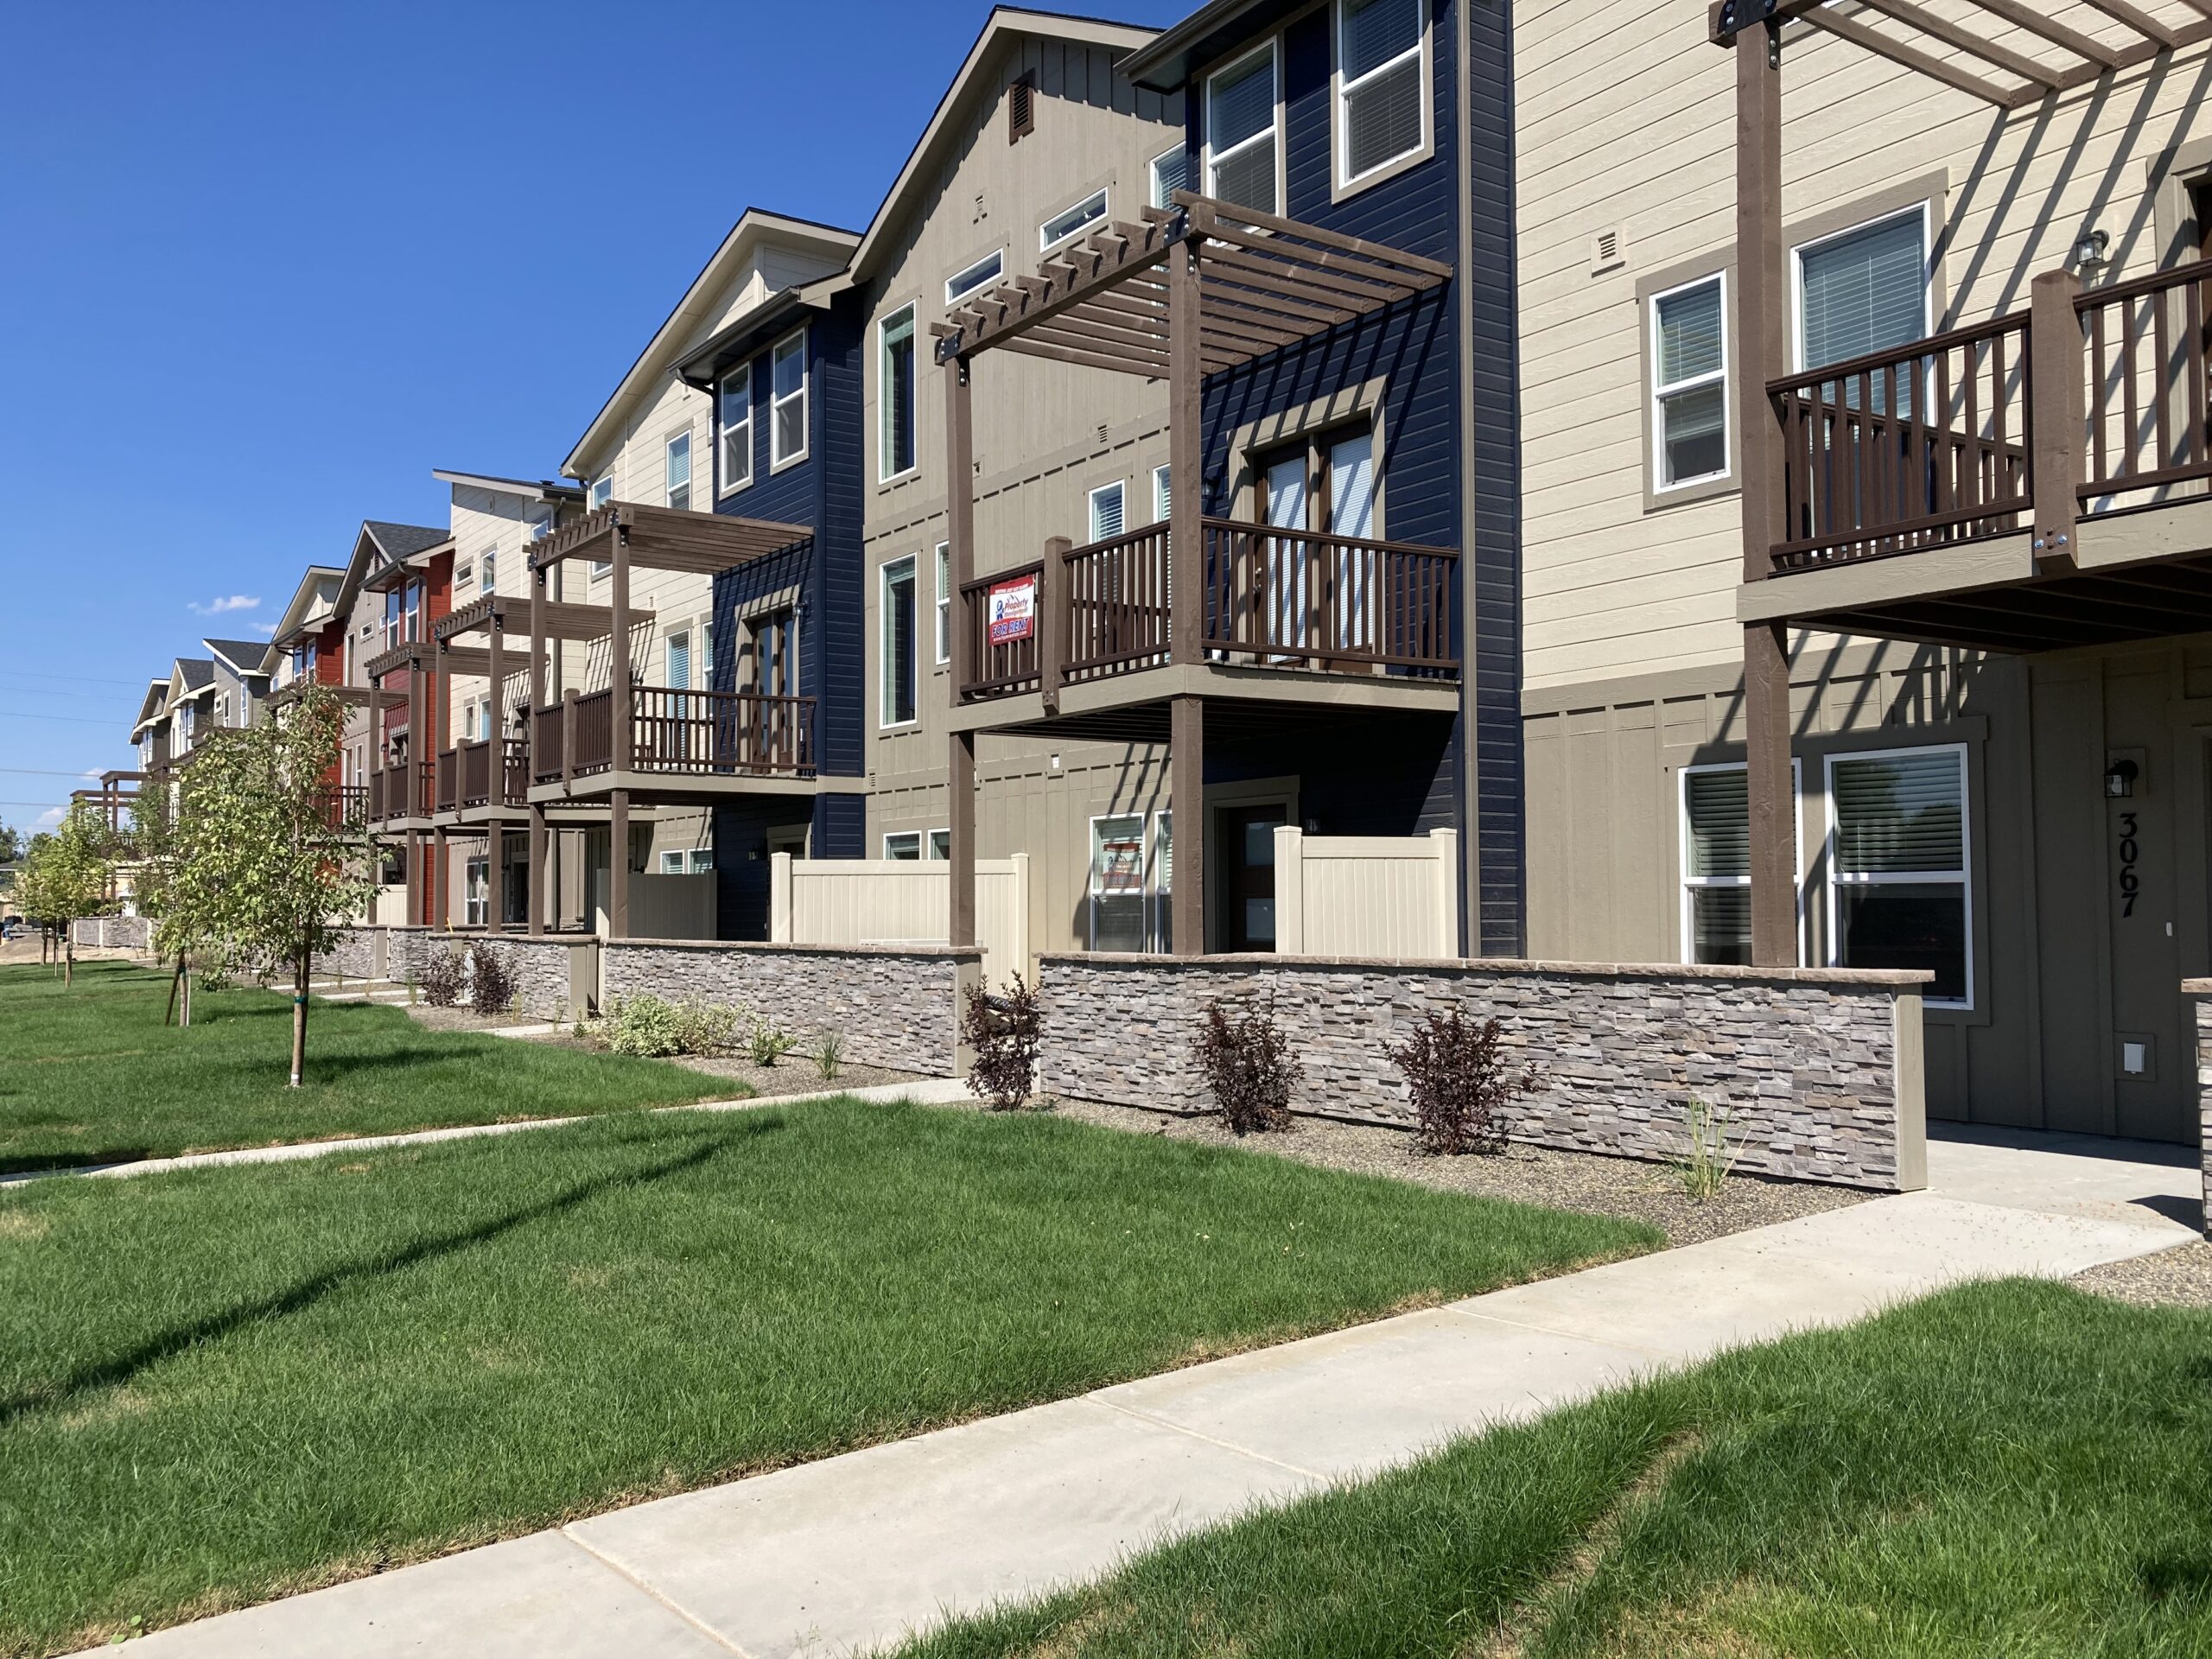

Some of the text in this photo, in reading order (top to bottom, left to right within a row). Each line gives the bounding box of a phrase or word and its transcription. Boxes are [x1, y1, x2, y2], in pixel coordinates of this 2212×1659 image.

[1004, 597, 1028, 610] Property
[992, 618, 1029, 638] FOR RENT
[2119, 812, 2139, 918] 3067
